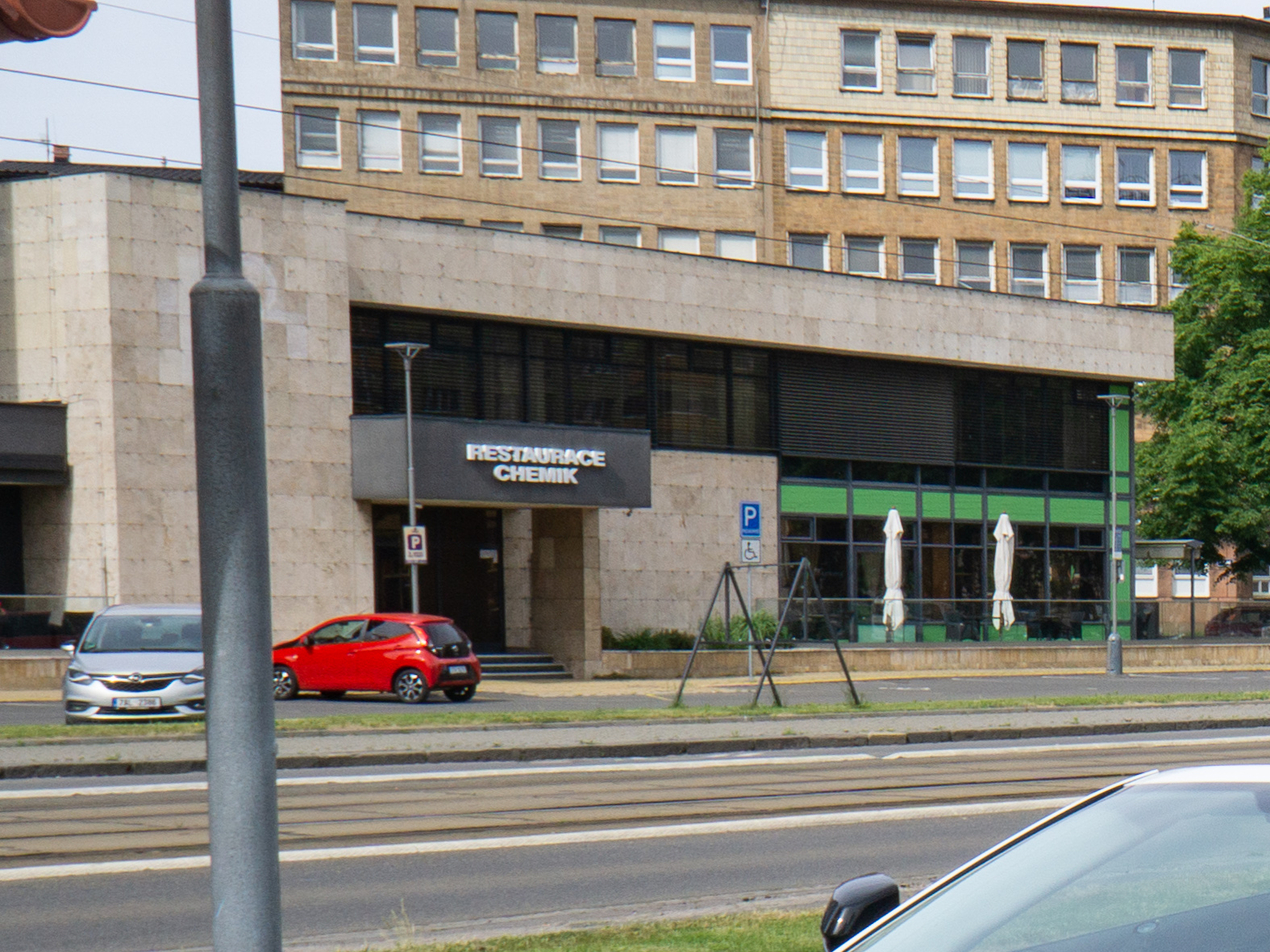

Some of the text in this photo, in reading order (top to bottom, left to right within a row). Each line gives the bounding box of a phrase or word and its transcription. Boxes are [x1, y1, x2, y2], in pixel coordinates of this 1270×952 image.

[466, 443, 606, 467] RESTAURACE
[493, 464, 579, 484] CHEMIK
[745, 506, 757, 526] P
[411, 536, 421, 549] P
